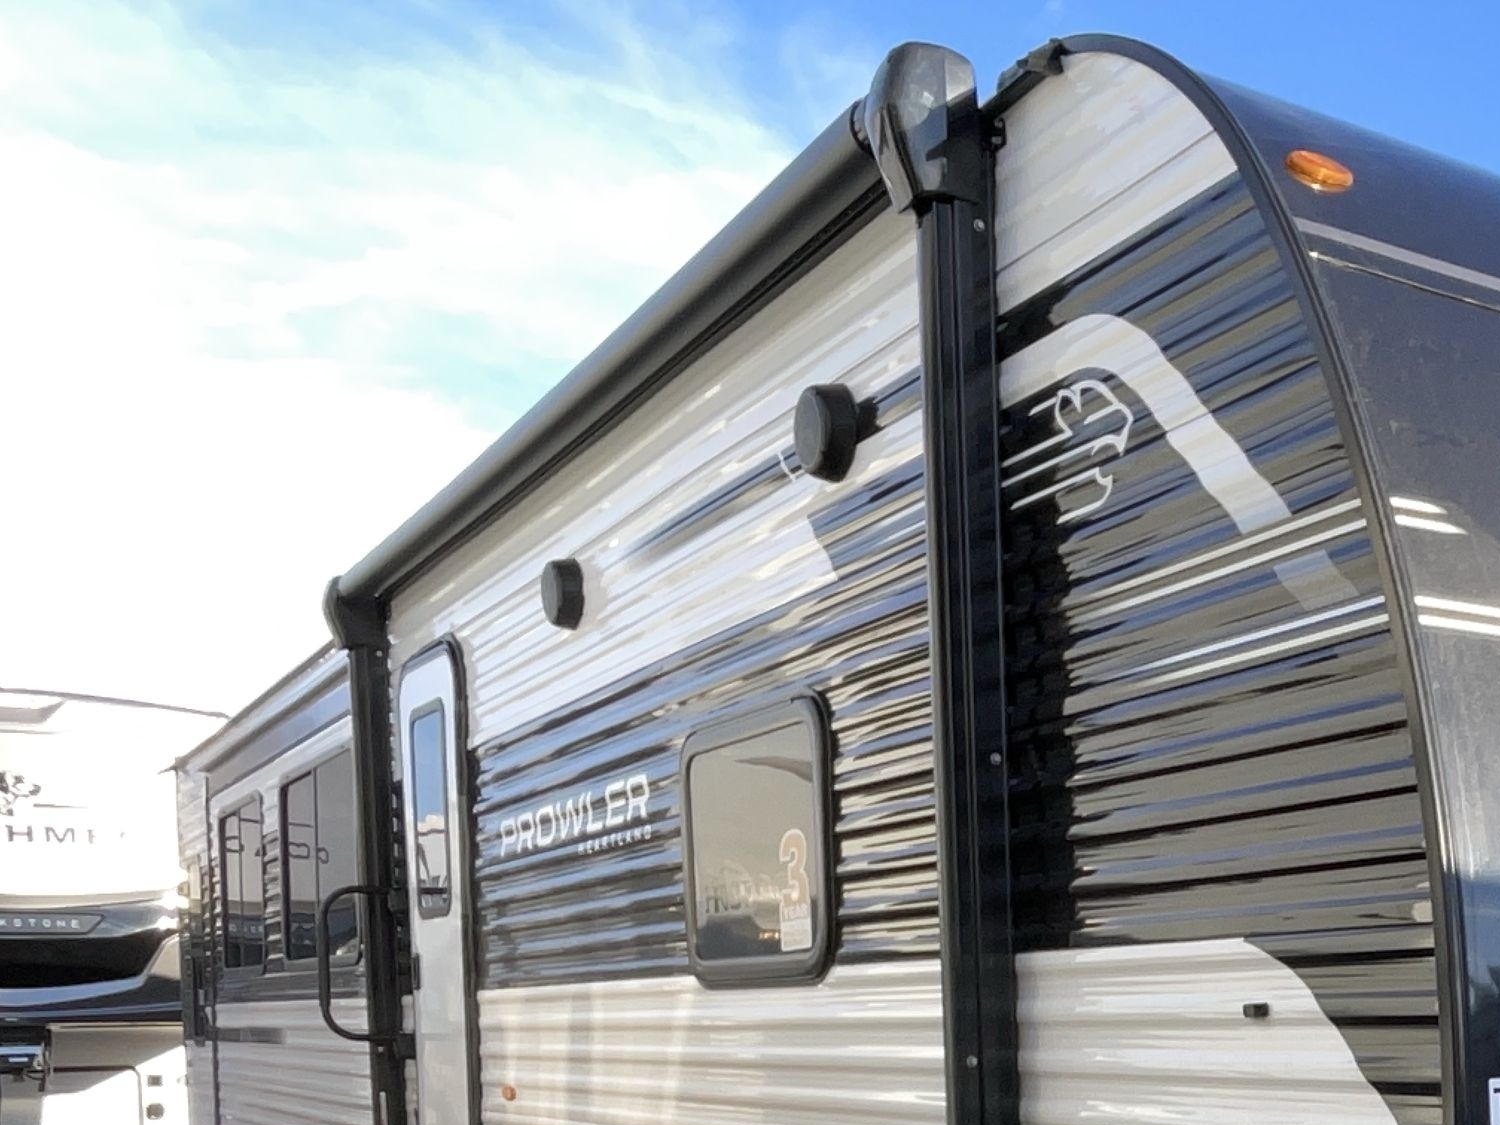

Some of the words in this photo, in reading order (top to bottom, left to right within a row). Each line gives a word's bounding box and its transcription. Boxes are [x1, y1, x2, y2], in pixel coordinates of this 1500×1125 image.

[5, 824, 126, 844] HM
[499, 773, 651, 857] PROWLER
[578, 824, 652, 855] HEARTLAND
[779, 828, 810, 904] 3
